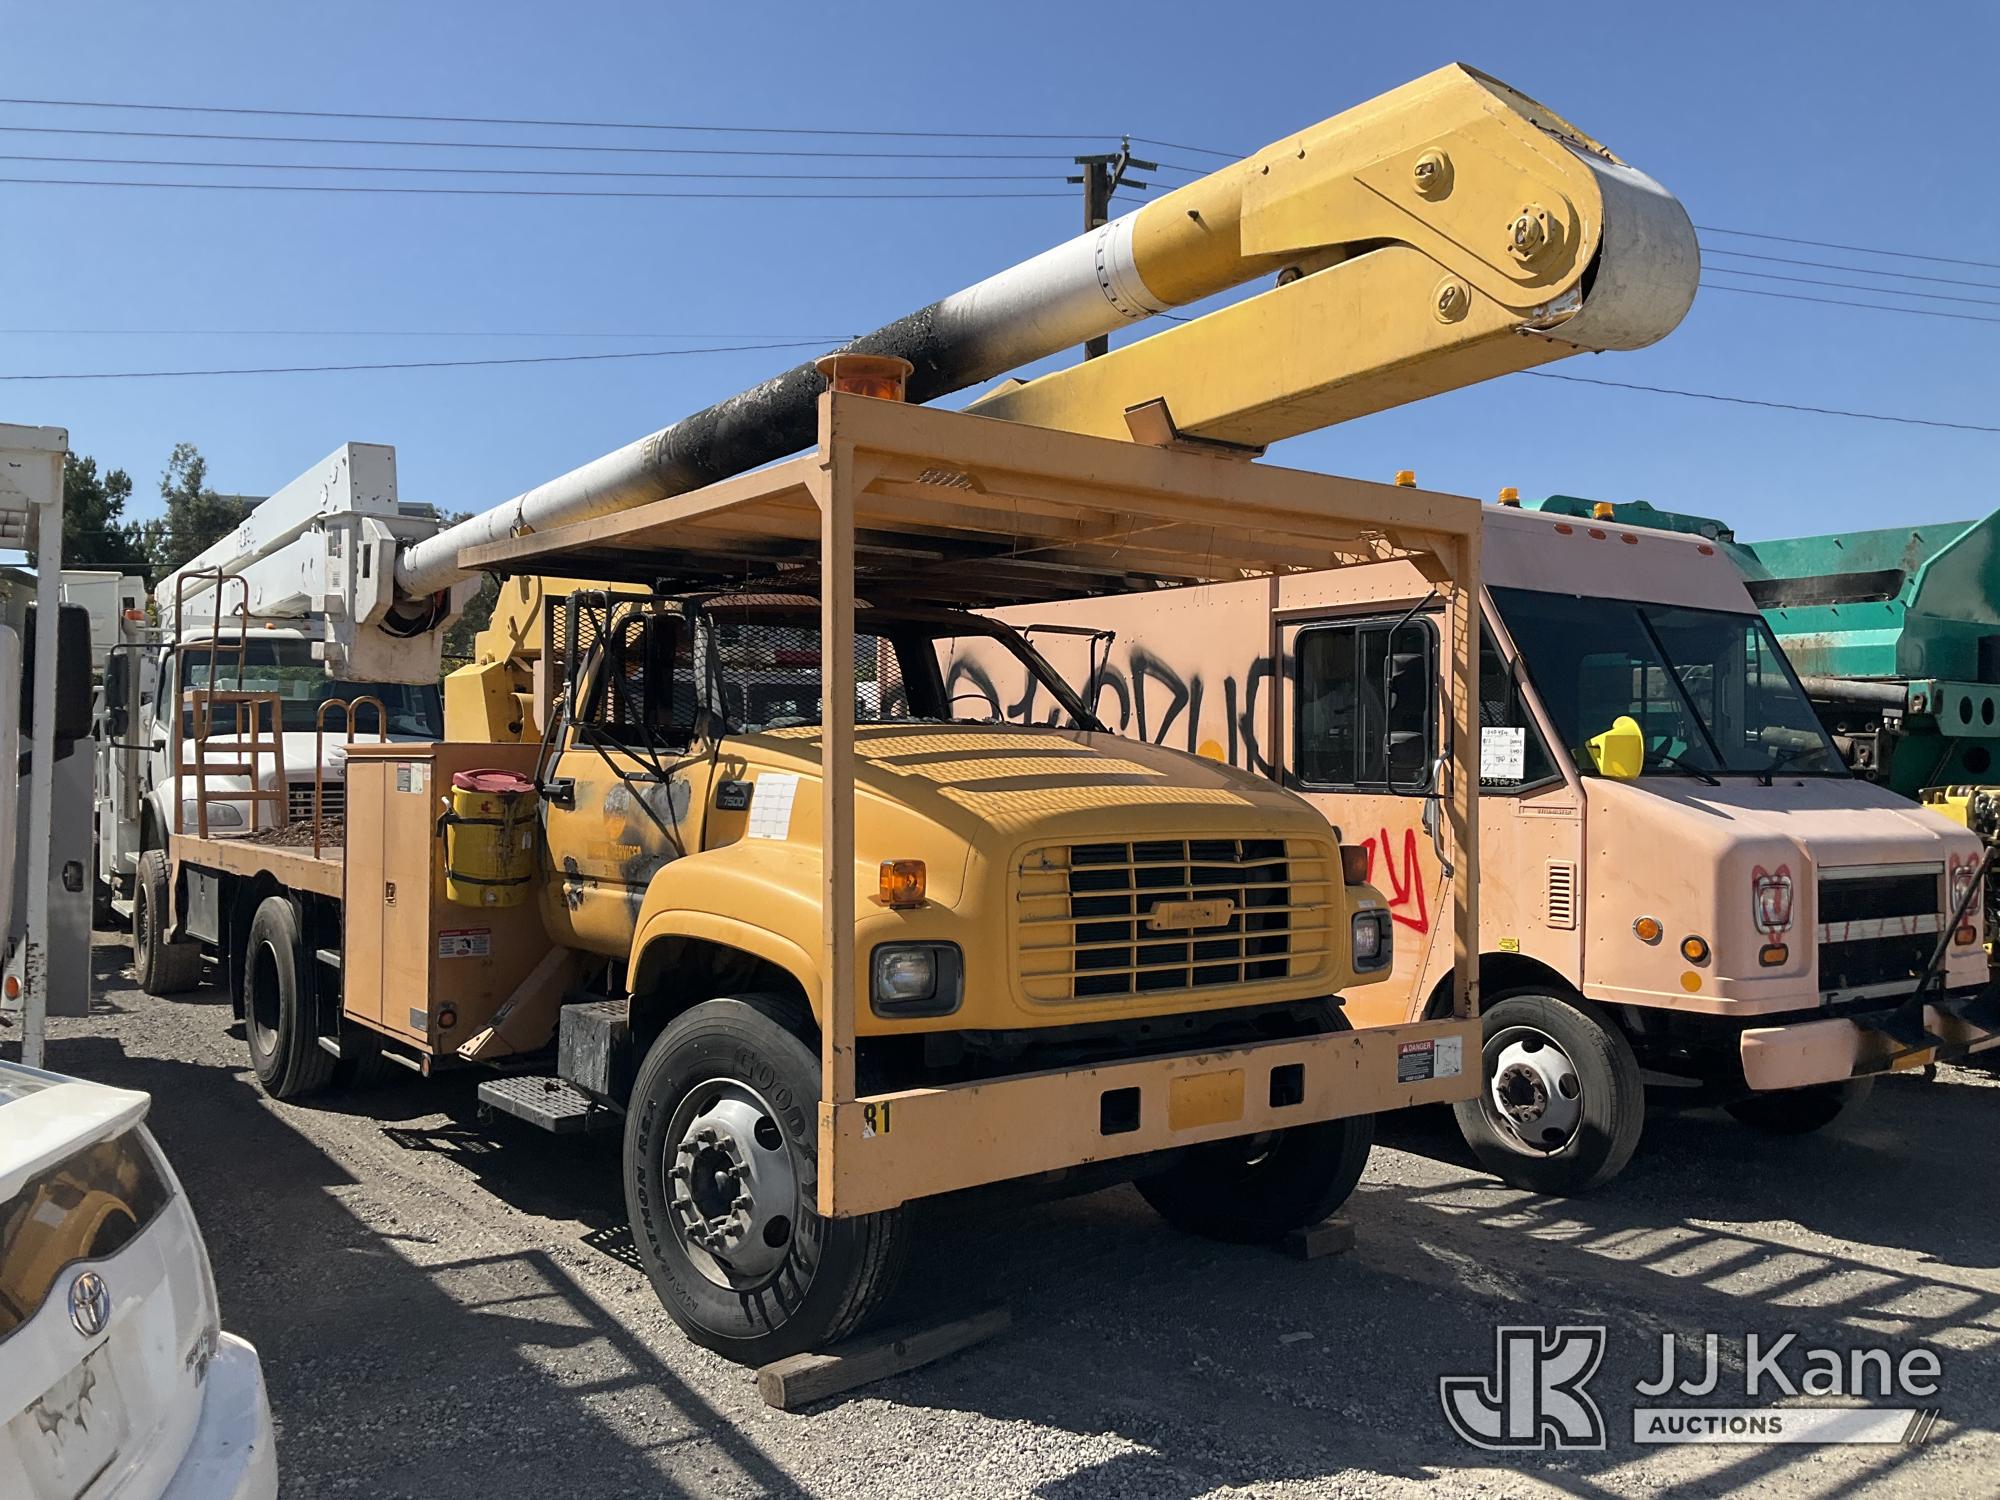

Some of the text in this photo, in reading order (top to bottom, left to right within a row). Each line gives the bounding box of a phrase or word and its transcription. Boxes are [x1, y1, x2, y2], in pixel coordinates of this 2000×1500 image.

[723, 796, 745, 807] 7500
[1408, 1042, 1431, 1052] DANGER
[863, 1101, 890, 1134] 81
